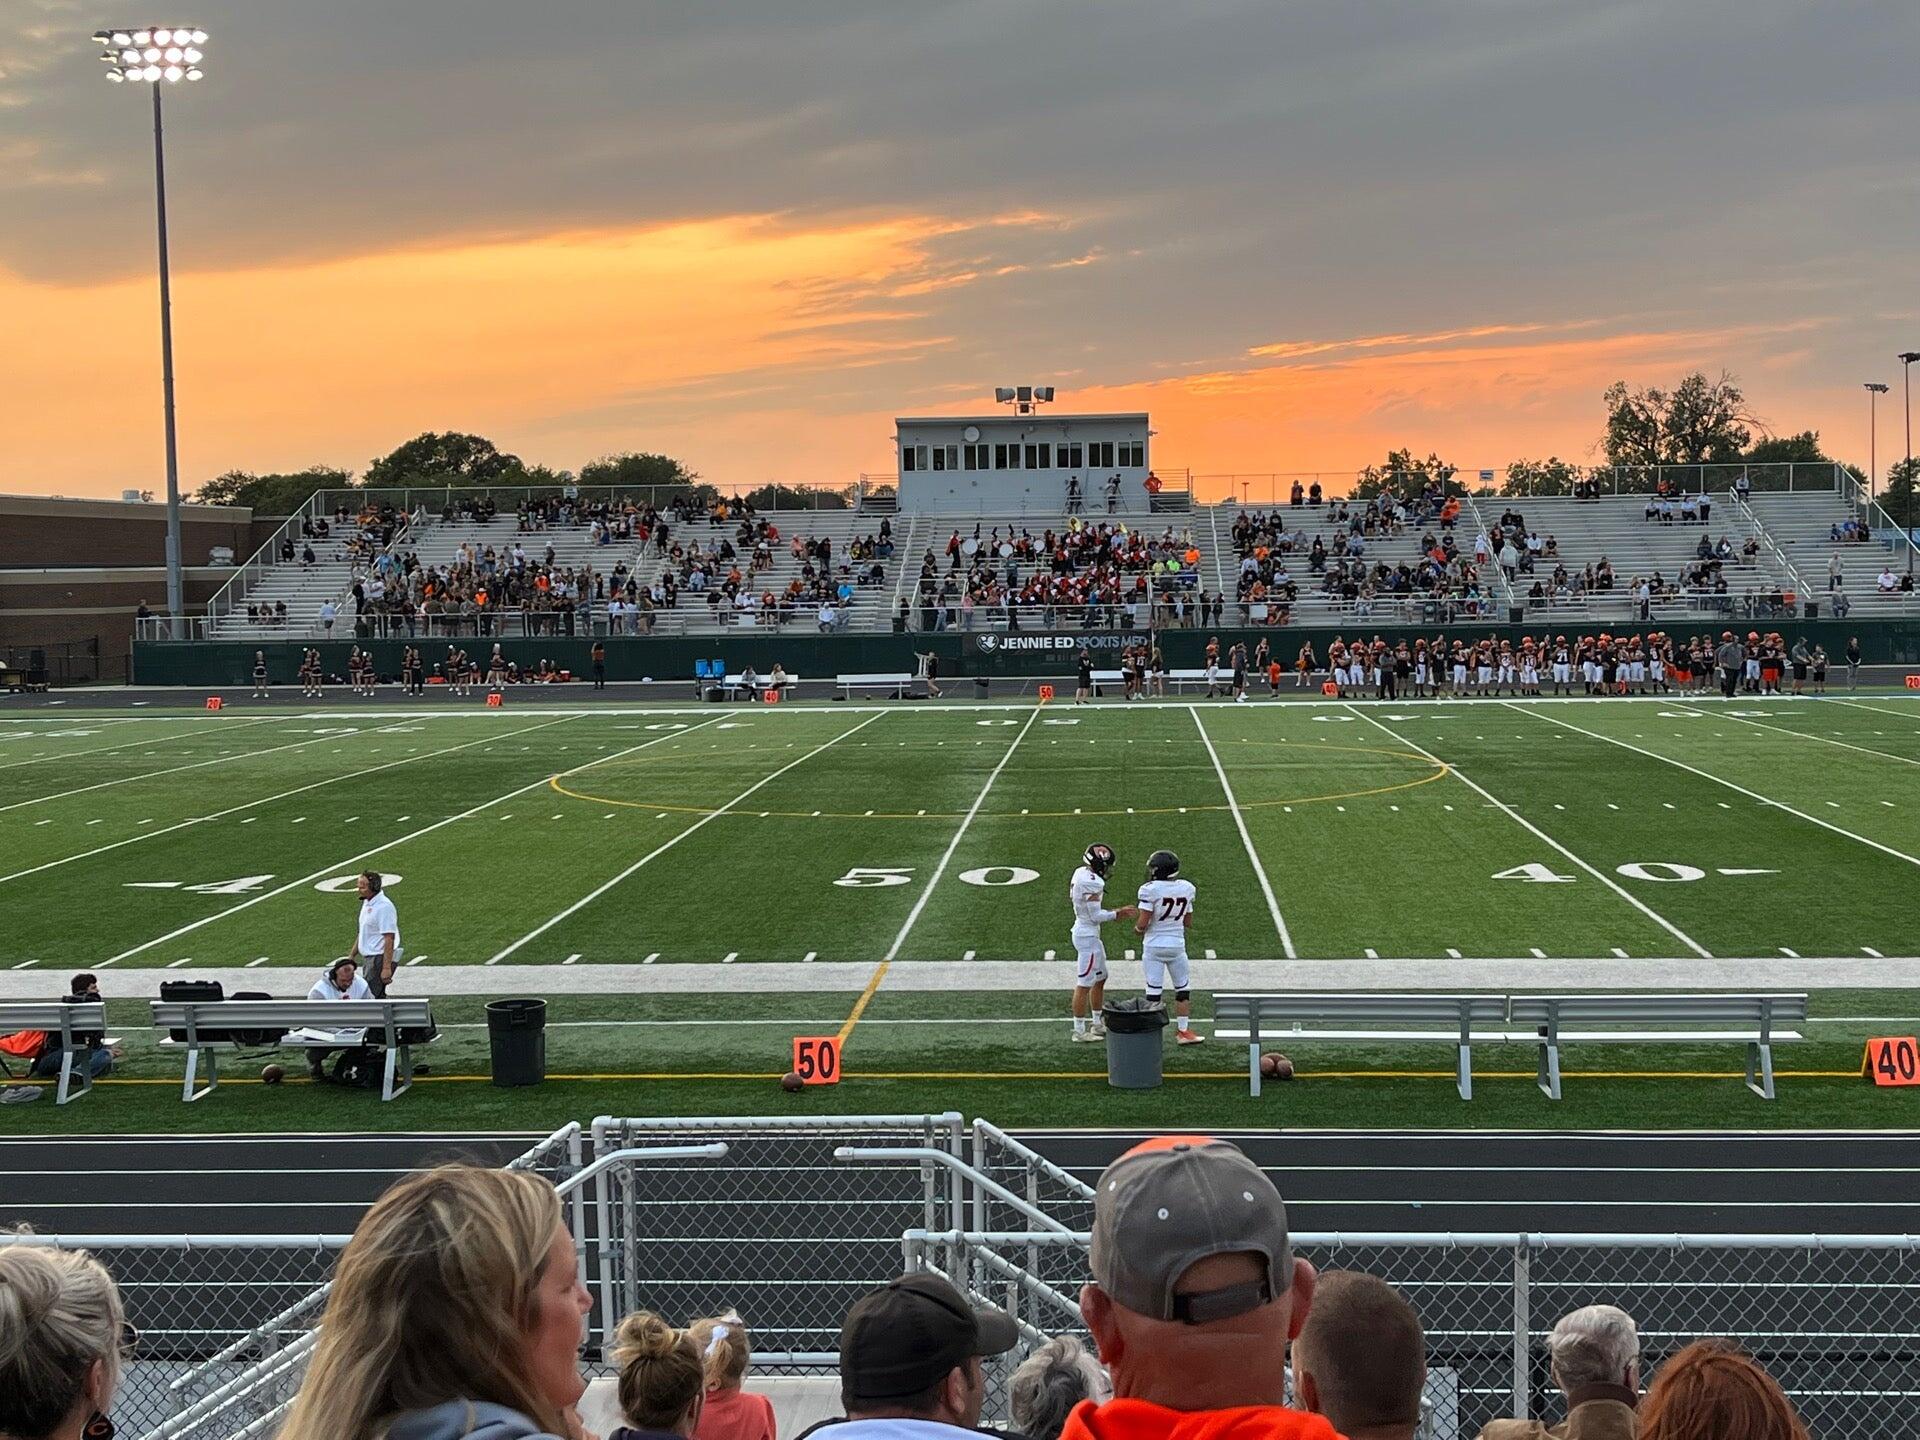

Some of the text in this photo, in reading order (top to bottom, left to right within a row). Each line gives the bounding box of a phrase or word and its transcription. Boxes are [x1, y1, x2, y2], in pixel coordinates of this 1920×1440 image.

[1000, 637, 1052, 650] JENNIE
[1055, 637, 1075, 648] ED
[1076, 636, 1119, 649] SPORTS
[1557, 652, 1568, 662] 71
[1908, 678, 1920, 688] 20
[1041, 687, 1052, 698] 50
[1325, 684, 1335, 694] 40
[488, 695, 498, 706] 30
[765, 693, 777, 702] 40
[207, 698, 218, 709] 20
[1158, 897, 1188, 921] 77
[798, 1041, 835, 1079] 50
[1878, 1041, 1915, 1080] 40
